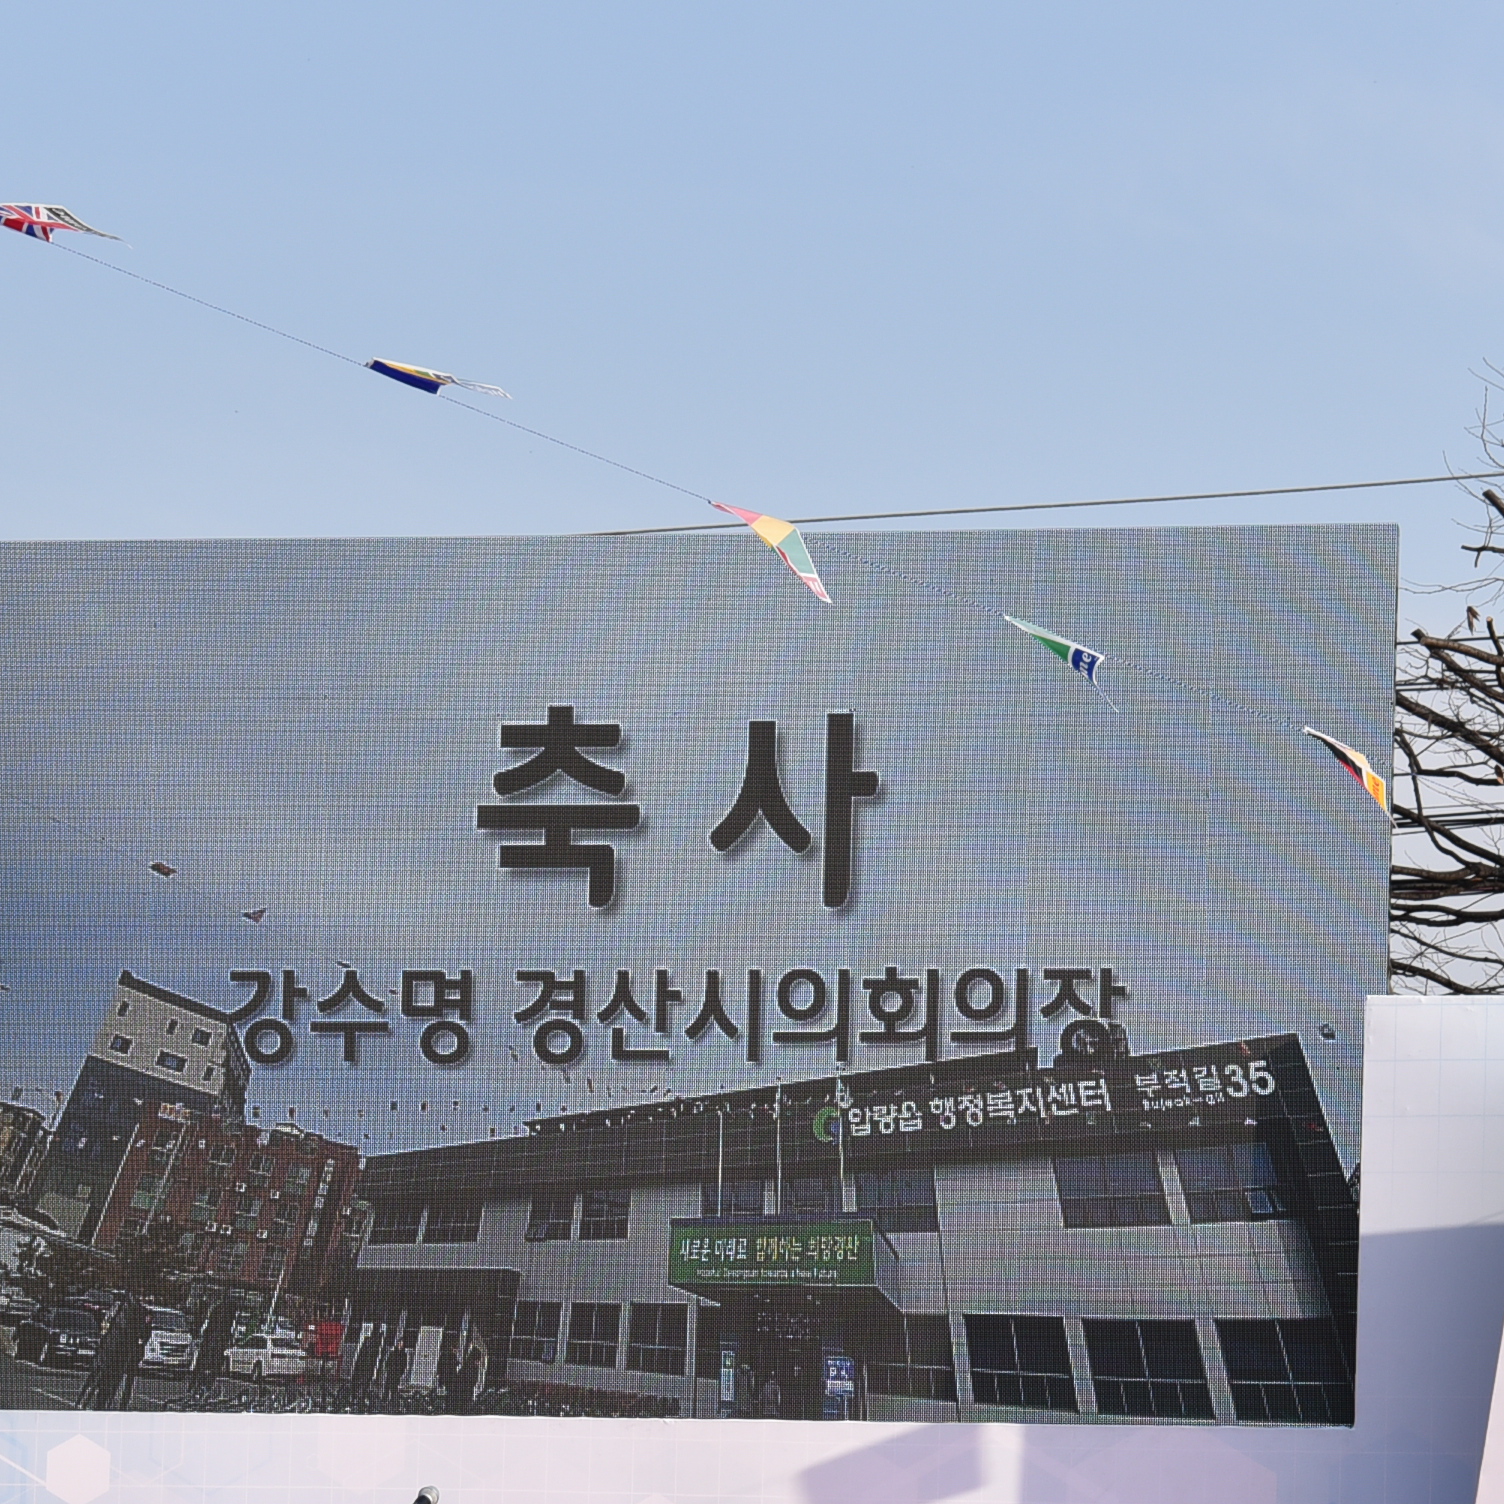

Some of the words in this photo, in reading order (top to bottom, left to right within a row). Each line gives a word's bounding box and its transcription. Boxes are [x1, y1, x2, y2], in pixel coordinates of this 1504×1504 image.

[476, 704, 642, 908] 축
[708, 711, 880, 909] 사
[228, 967, 474, 1066] 강수명
[514, 965, 1128, 1067] 경산시의회의장
[847, 1101, 923, 1137] 압량읍
[928, 1077, 1112, 1131] 행정복지센터
[1134, 1064, 1224, 1098] 부적길
[1224, 1060, 1276, 1098] 35
